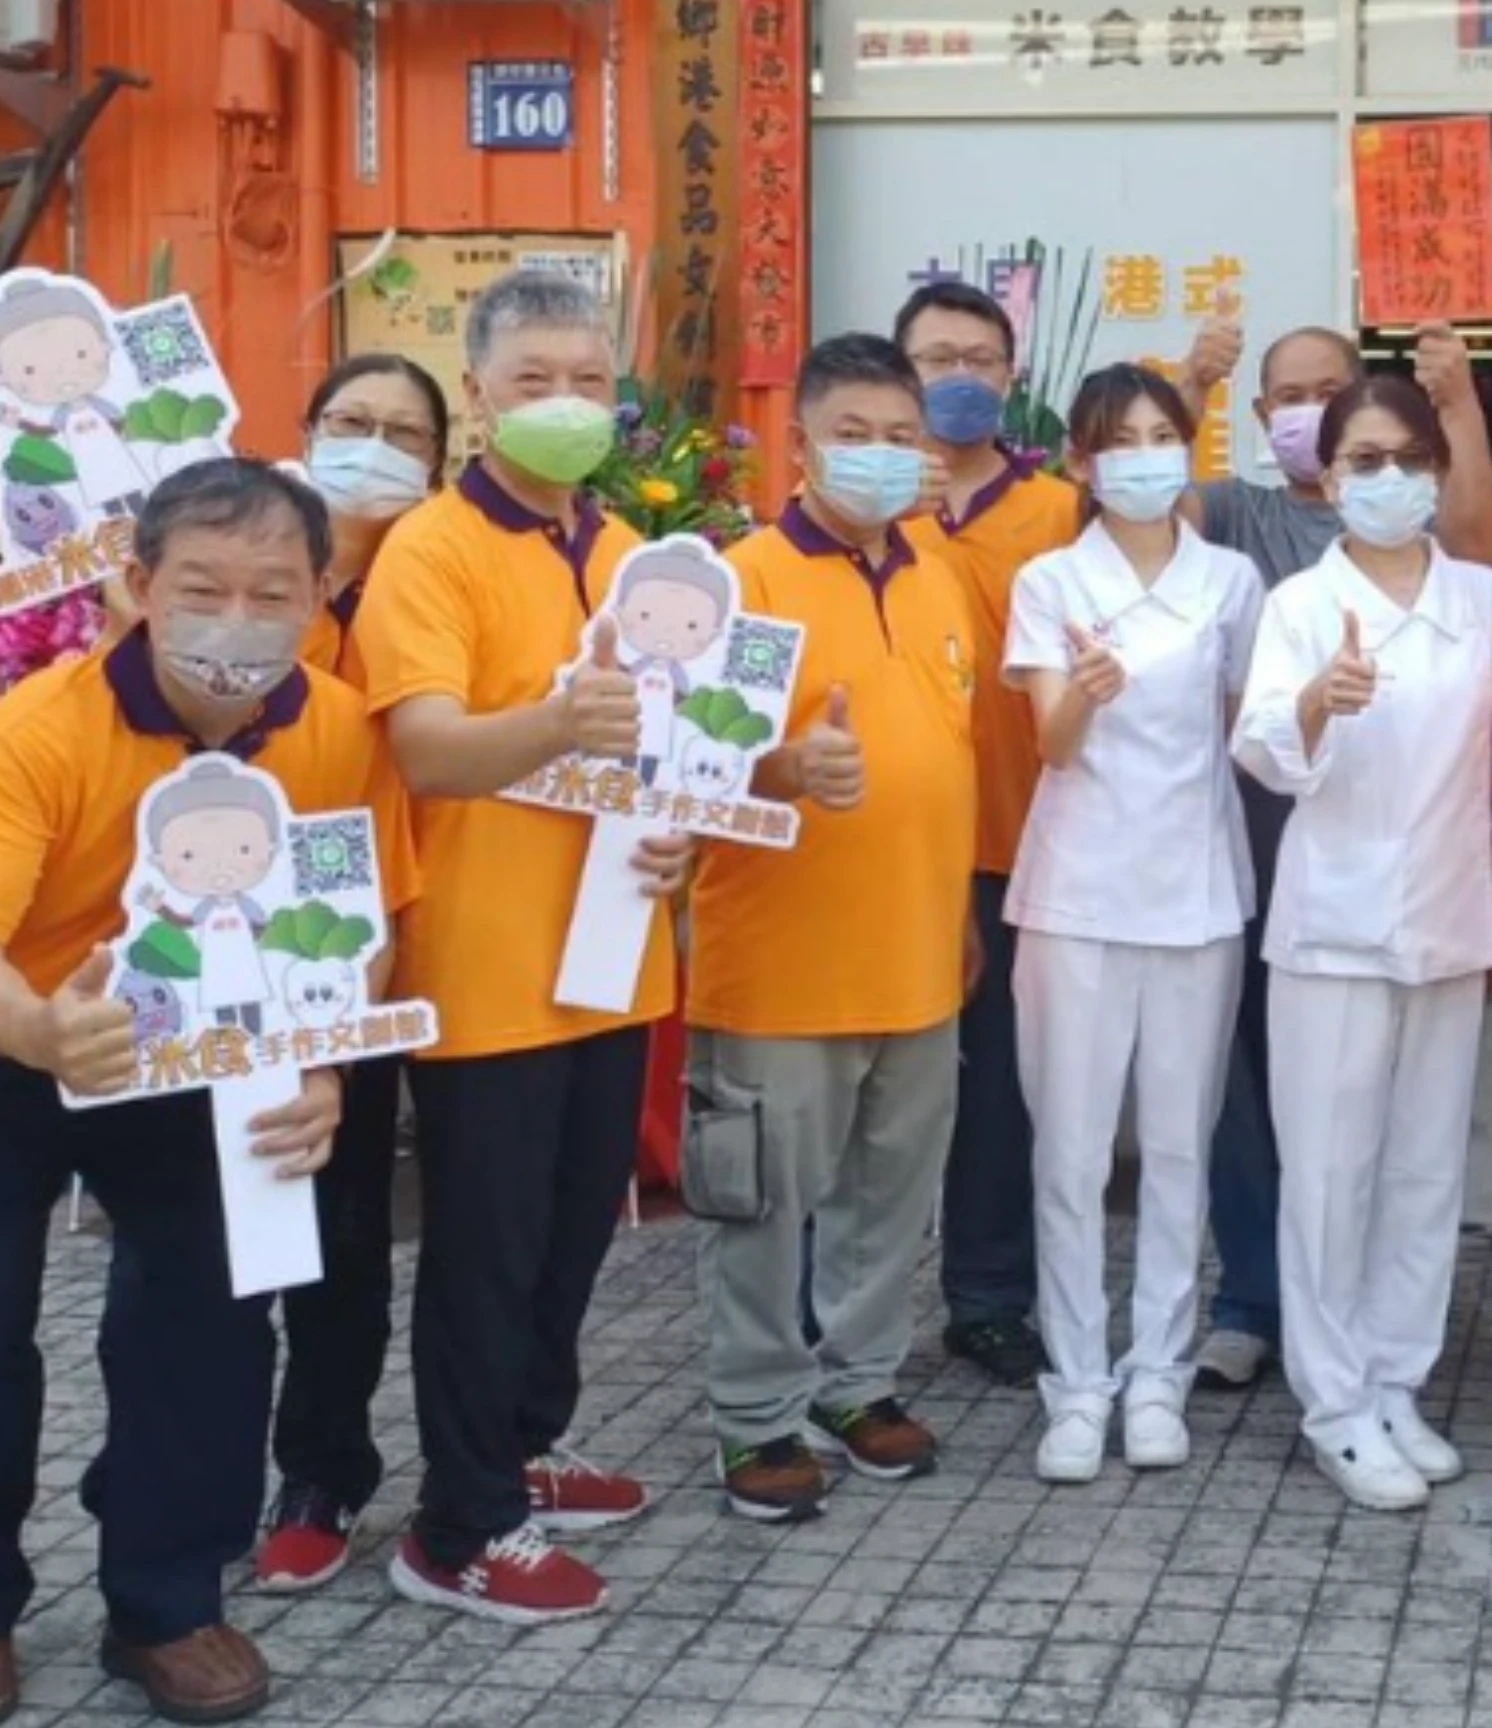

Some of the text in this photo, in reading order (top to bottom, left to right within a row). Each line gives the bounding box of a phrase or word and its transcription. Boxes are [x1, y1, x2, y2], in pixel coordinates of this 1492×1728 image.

[1009, 7, 1305, 68] 米食教學
[493, 91, 568, 138] 160
[1103, 254, 1242, 317] 港式
